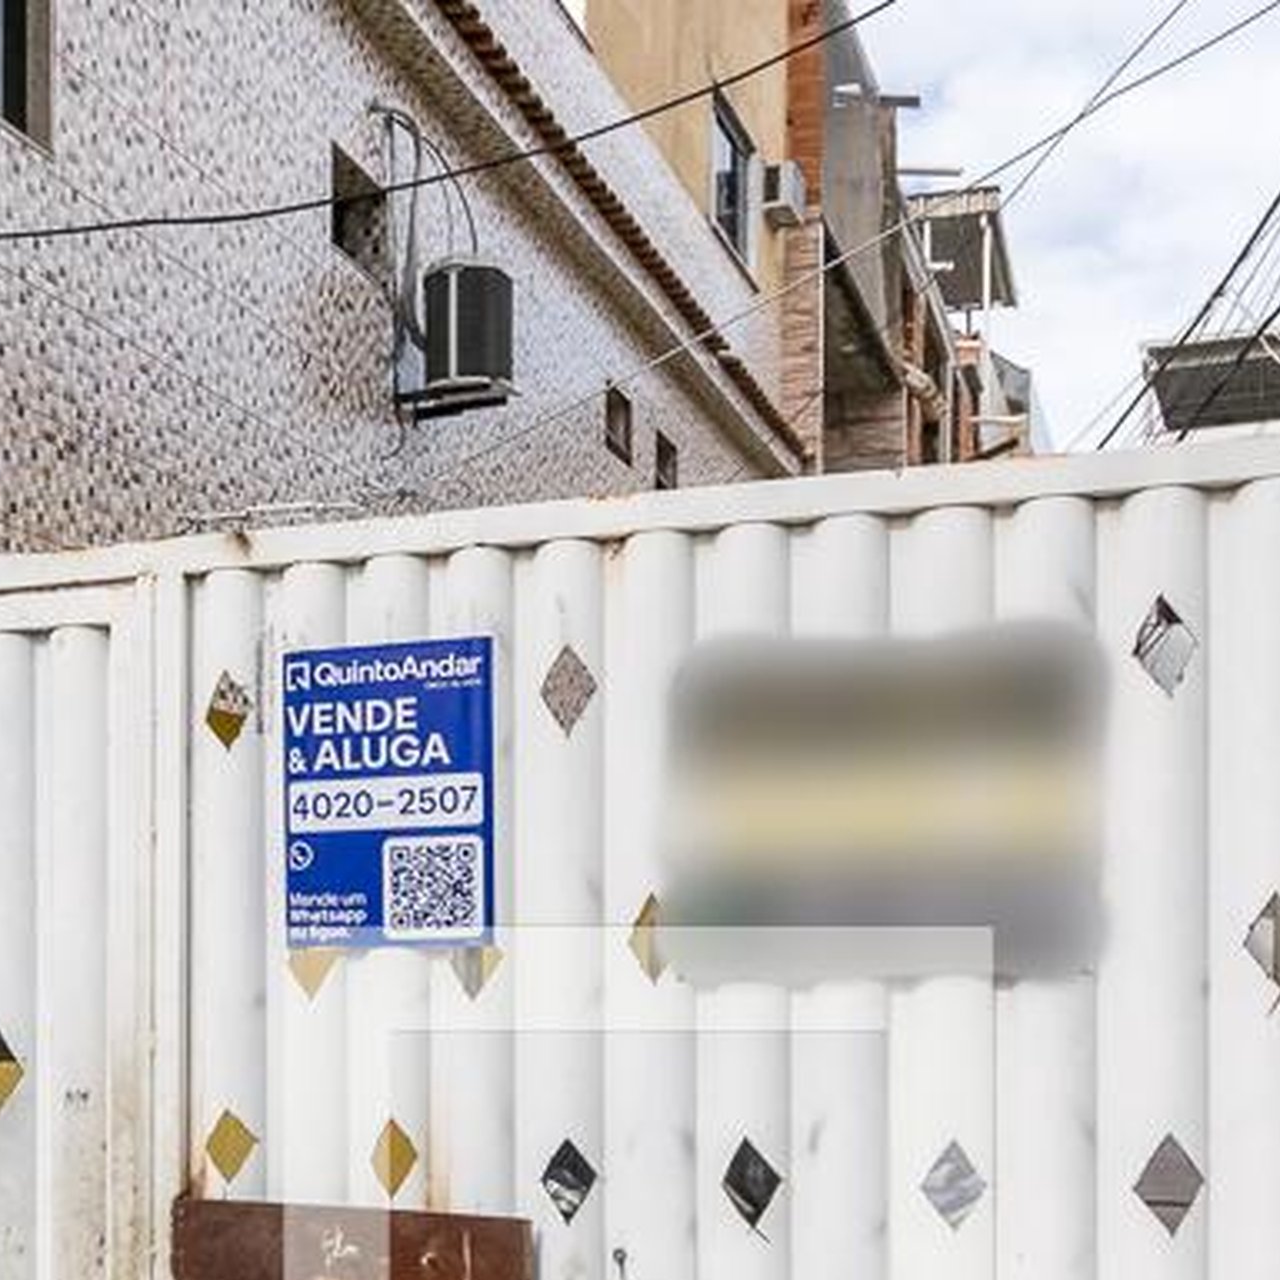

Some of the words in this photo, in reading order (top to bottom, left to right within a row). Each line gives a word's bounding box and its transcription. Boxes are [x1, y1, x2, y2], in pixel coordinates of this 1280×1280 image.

[313, 653, 482, 687] QuintoAndar
[287, 697, 418, 737] VENDE
[288, 747, 307, 775] &
[314, 733, 451, 772] ALUGA
[292, 785, 478, 820] 4020-2507
